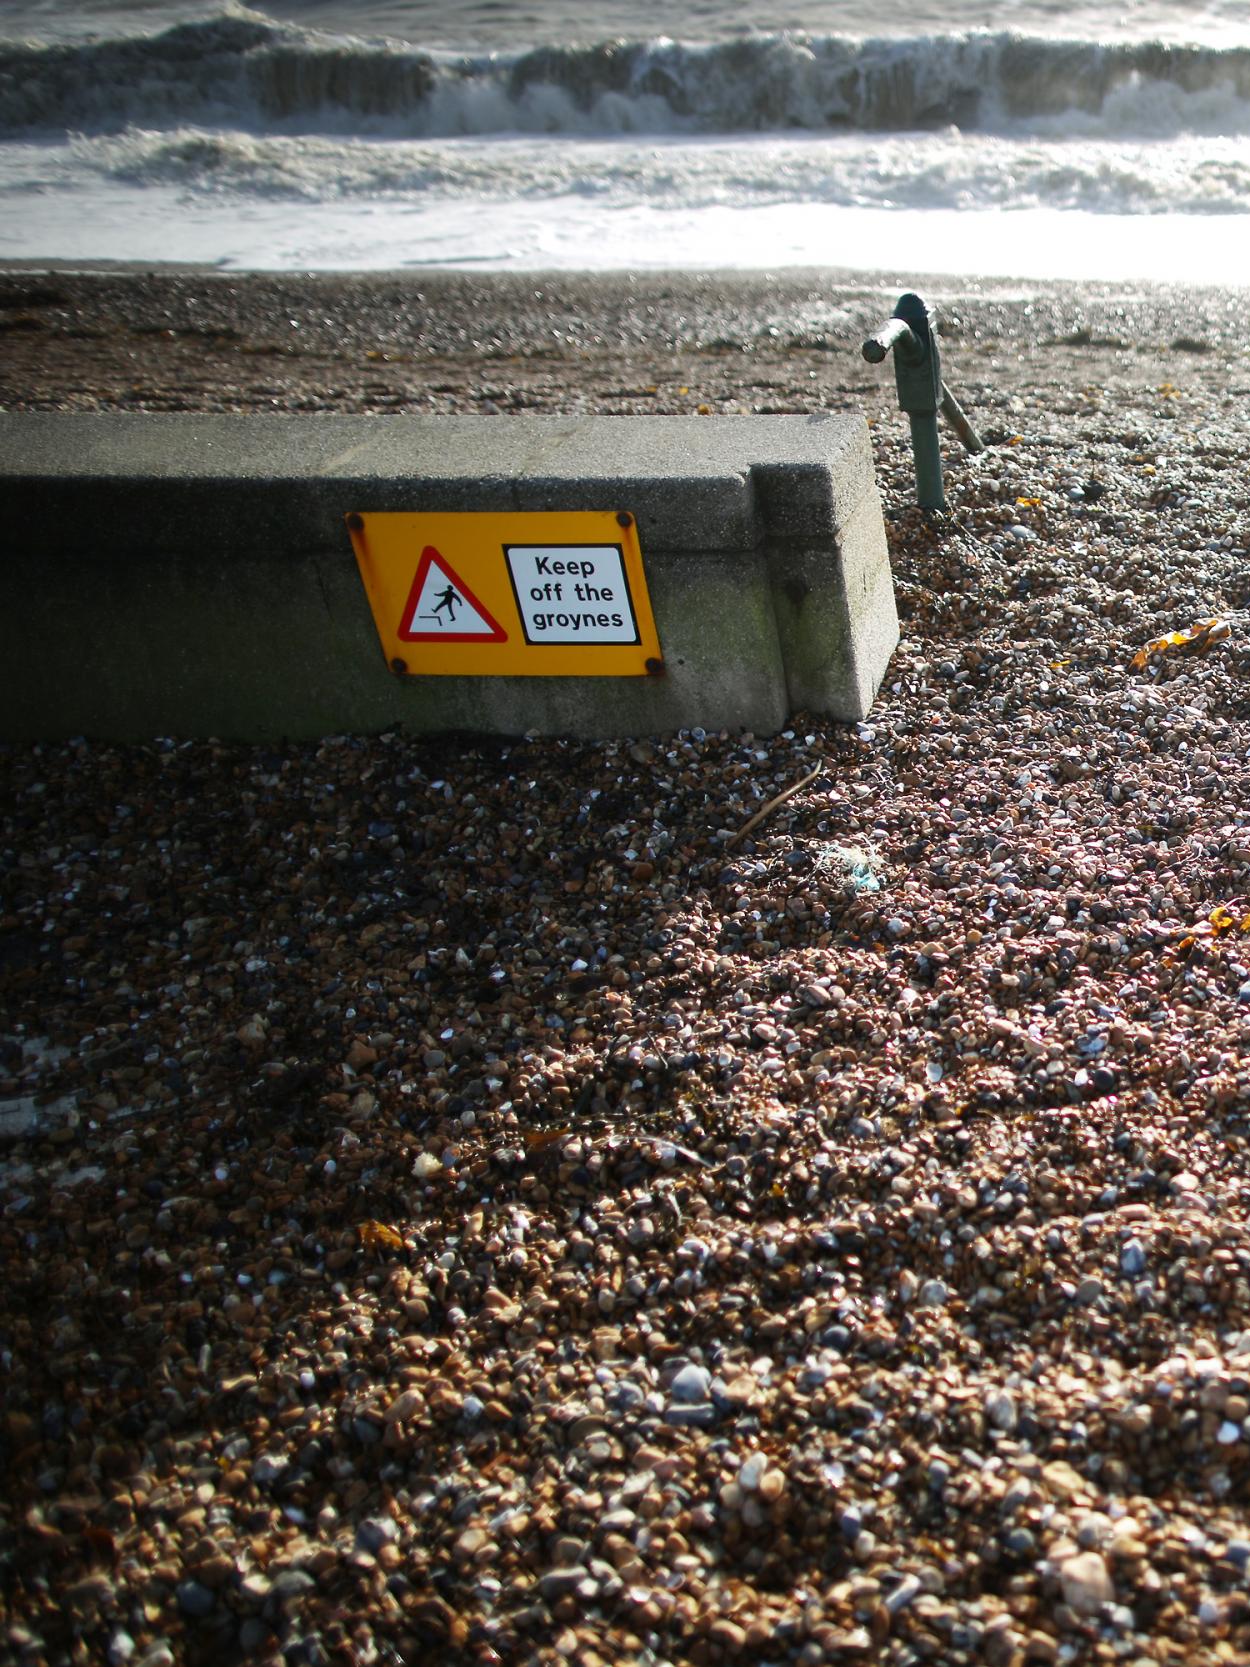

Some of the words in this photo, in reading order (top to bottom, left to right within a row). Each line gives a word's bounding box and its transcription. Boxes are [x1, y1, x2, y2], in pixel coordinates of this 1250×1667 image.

[534, 556, 595, 578] Keep
[530, 583, 562, 601] off
[574, 583, 614, 601] the
[533, 613, 624, 631] groynes
